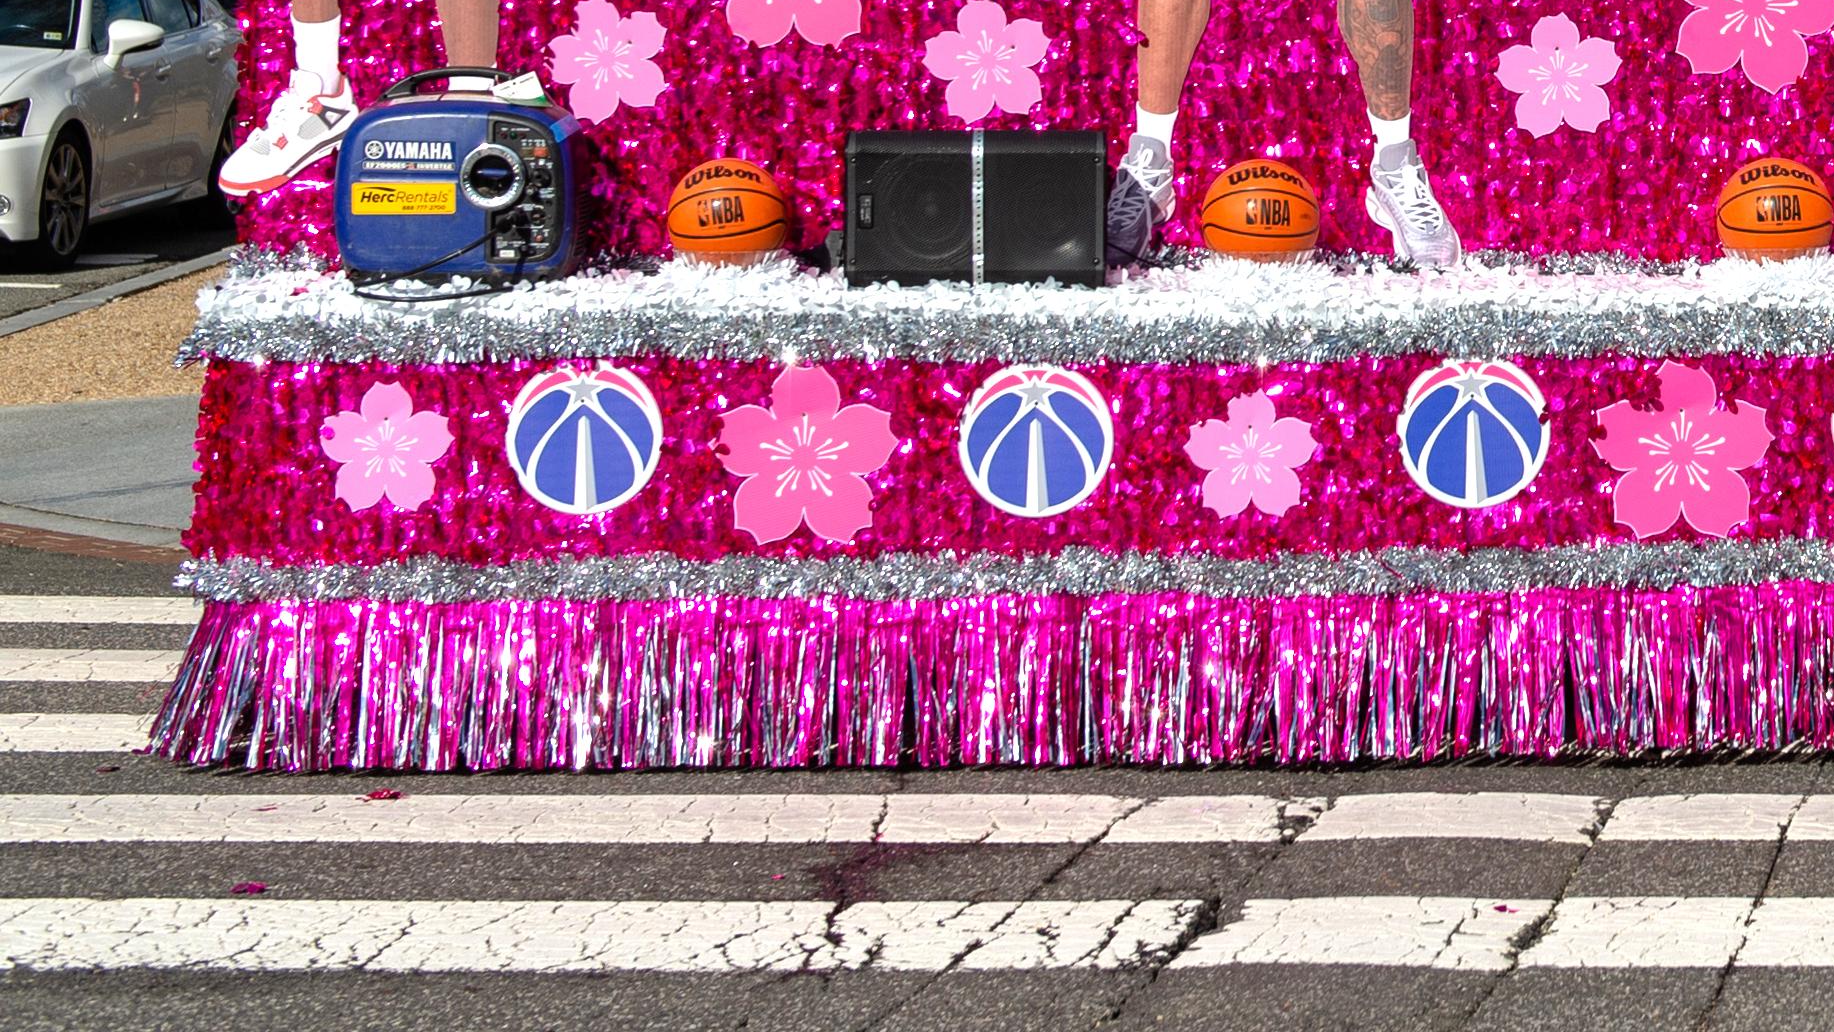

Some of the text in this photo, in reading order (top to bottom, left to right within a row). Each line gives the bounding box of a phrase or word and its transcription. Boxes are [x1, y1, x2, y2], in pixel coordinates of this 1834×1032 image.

[385, 141, 453, 160] YAMAHA
[684, 166, 763, 189] Wilson
[1227, 166, 1305, 189] Wilson
[1740, 164, 1818, 186] Wilson
[360, 191, 450, 204] HercRentals
[1771, 195, 1802, 222] NBA
[711, 195, 745, 225] NBA
[1260, 198, 1291, 227] NBA
